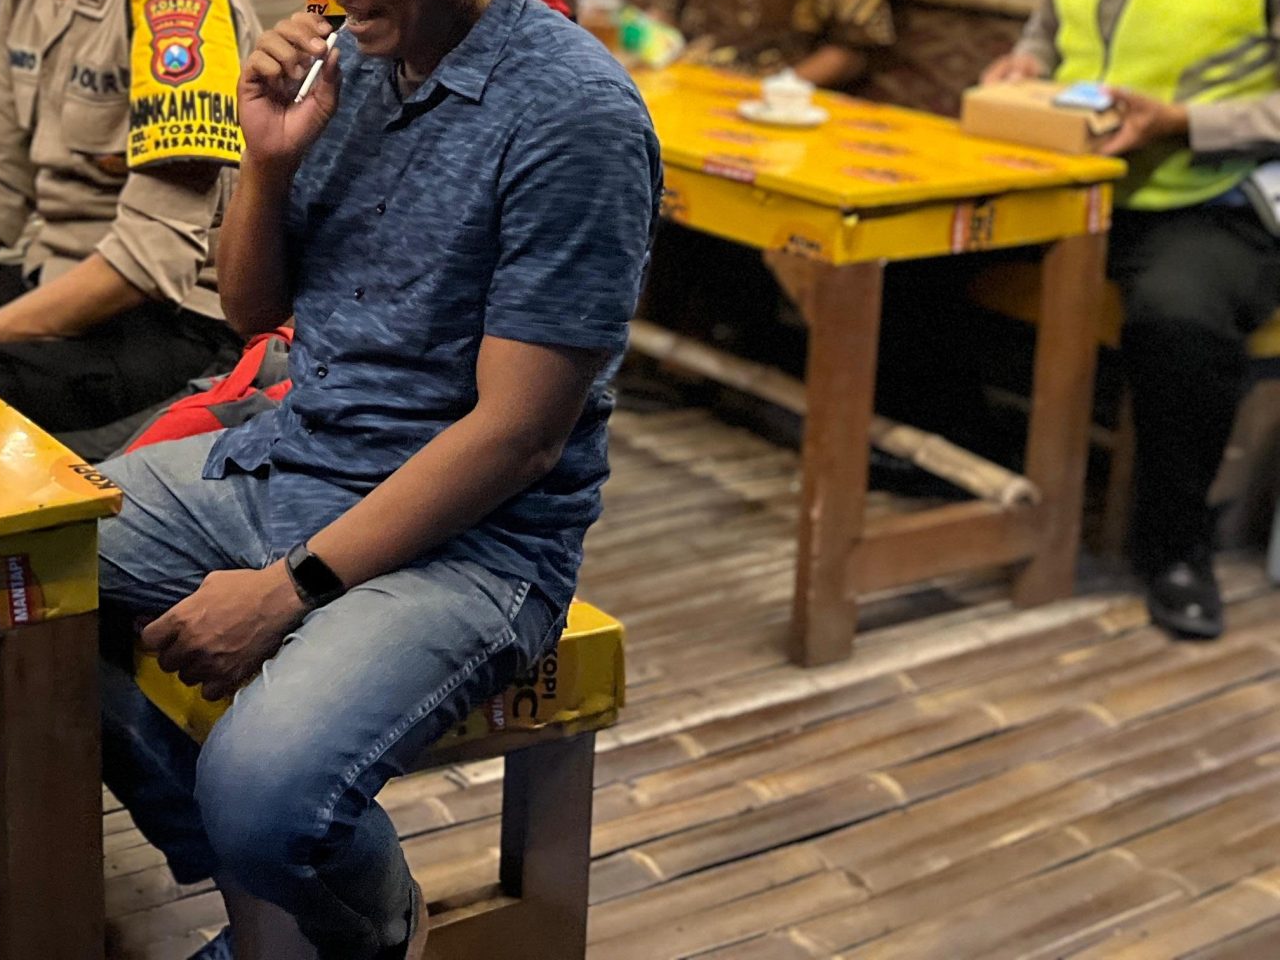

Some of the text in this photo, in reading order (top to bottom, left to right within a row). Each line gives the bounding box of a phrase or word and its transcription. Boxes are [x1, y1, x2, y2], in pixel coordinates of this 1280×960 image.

[159, 123, 238, 140] TOSAREN
[154, 136, 241, 154] PESANTREN
[68, 463, 119, 490] KOPI
[8, 556, 29, 622] MANTAP!
